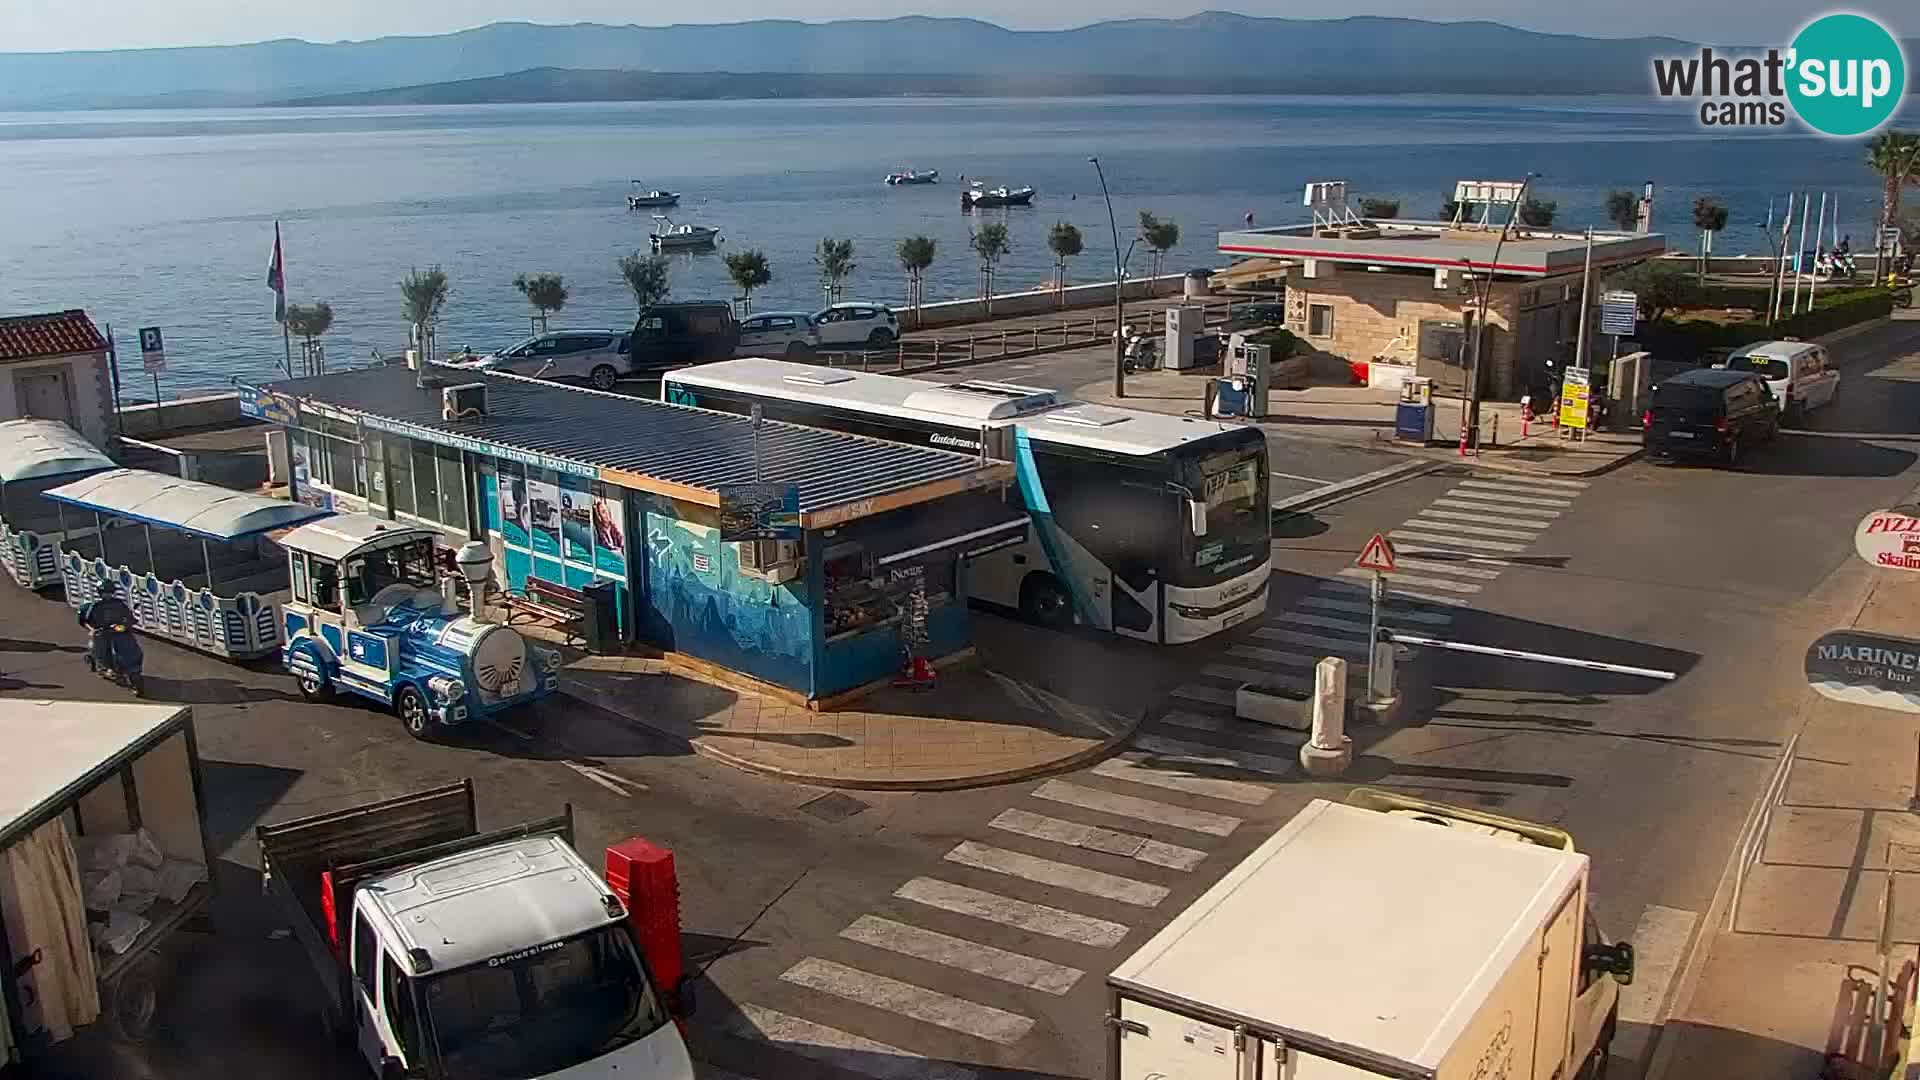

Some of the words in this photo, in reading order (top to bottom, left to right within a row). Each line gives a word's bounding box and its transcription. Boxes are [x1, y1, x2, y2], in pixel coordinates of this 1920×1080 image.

[145, 331, 157, 349] P
[490, 446, 507, 459] BUS
[508, 450, 539, 464] STATION
[543, 458, 566, 471] TICKET
[568, 463, 595, 476] OFFICE
[1817, 645, 1920, 670] MARINE
[1888, 669, 1912, 682] bar
